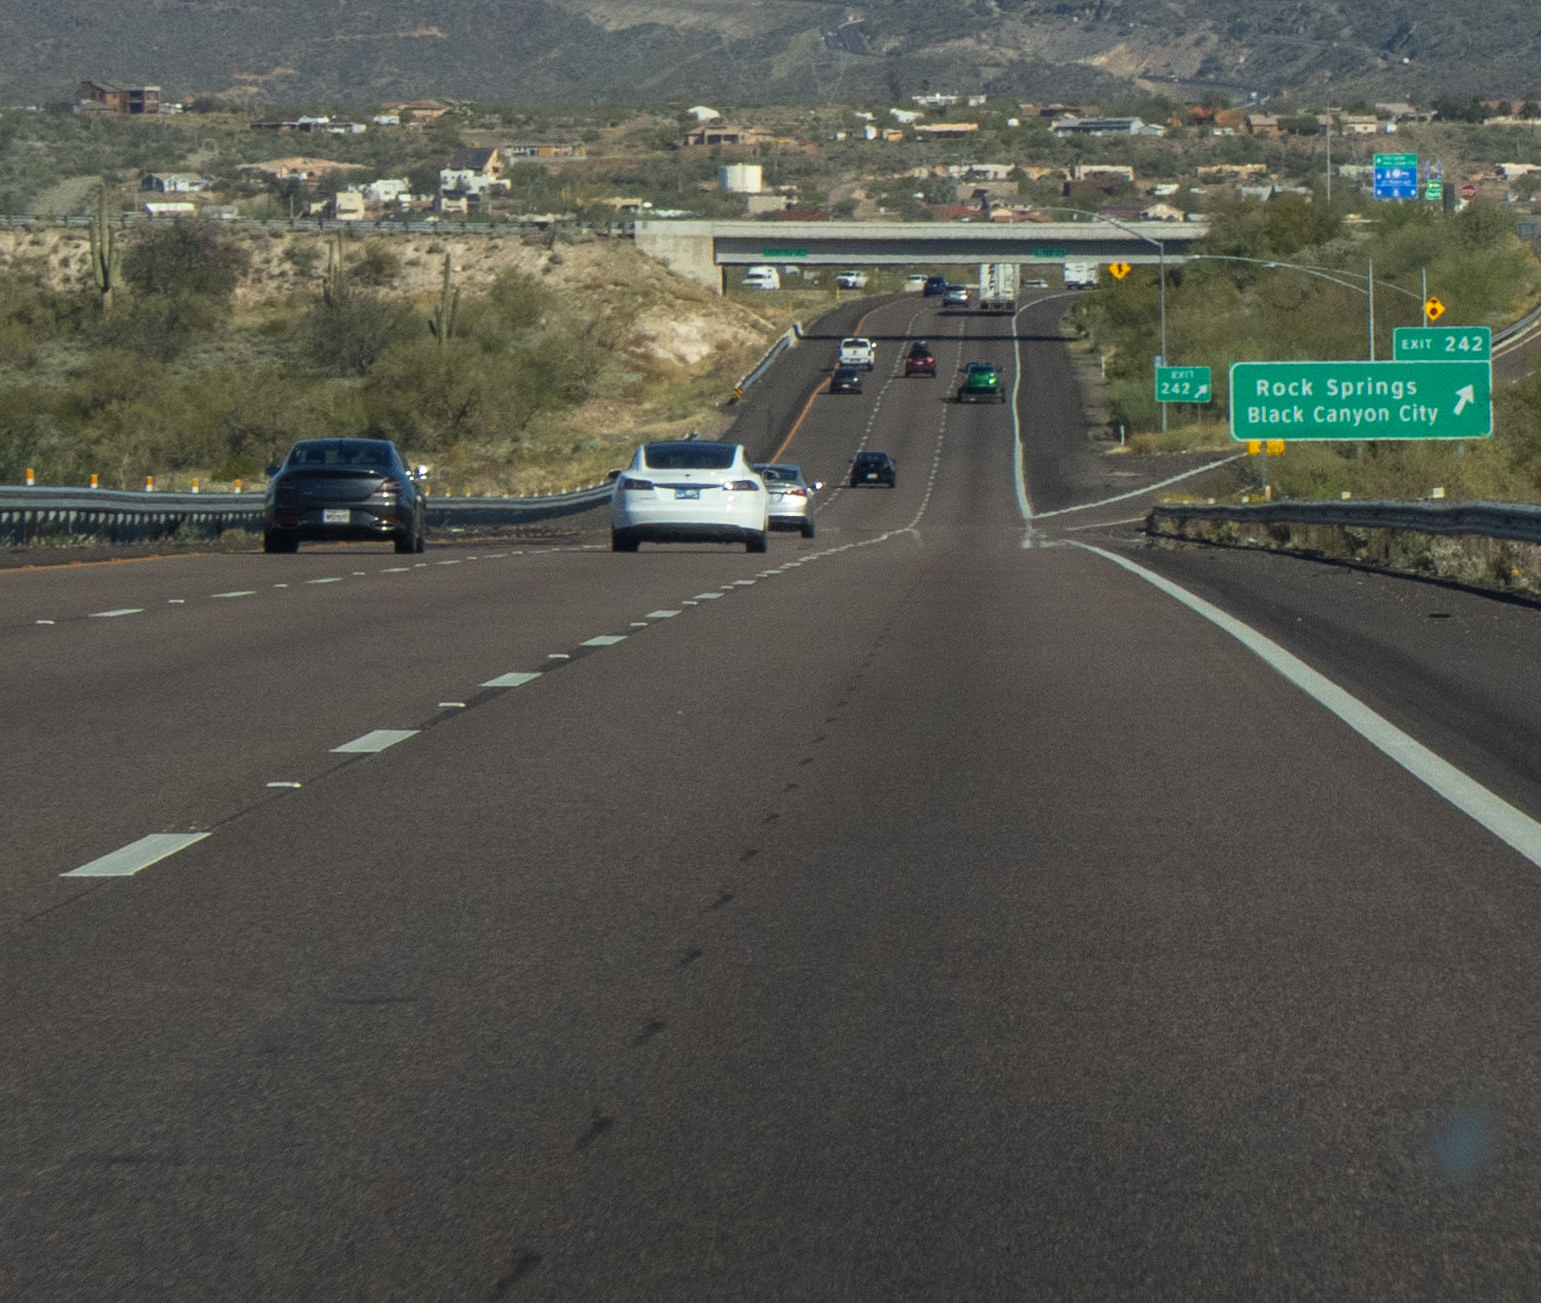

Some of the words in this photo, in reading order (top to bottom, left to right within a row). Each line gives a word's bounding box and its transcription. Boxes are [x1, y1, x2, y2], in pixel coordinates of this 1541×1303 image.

[1402, 339, 1431, 350] EXIT
[1445, 336, 1483, 352] 242
[1161, 382, 1190, 395] 242
[1257, 379, 1312, 396] Rock
[1327, 378, 1417, 399] Springs
[1248, 406, 1304, 423] Black
[1313, 406, 1389, 427] Canyon
[1399, 405, 1438, 426] City
